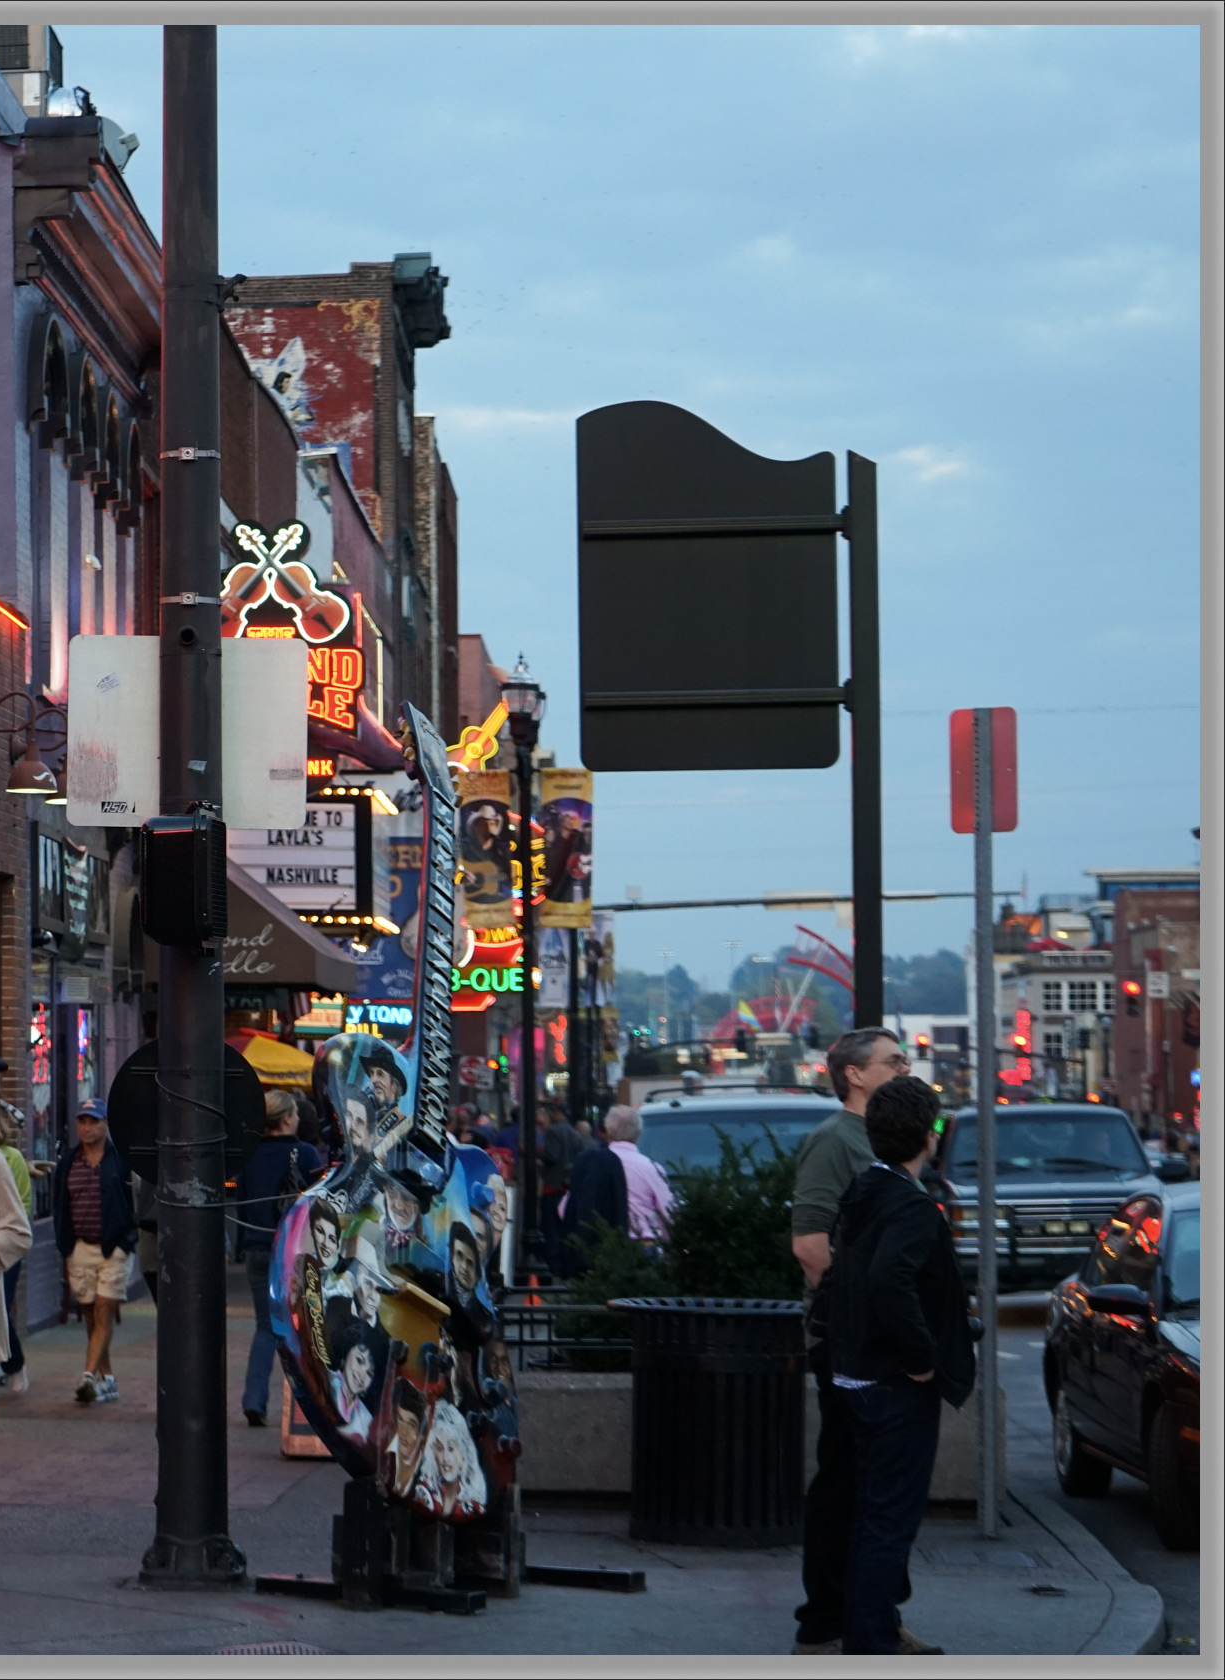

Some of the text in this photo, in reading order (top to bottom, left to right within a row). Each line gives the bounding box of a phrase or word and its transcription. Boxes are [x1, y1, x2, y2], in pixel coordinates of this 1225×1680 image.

[327, 811, 342, 826] TO
[267, 829, 324, 846] LAYLA'S
[266, 867, 338, 884] NASHVILLE
